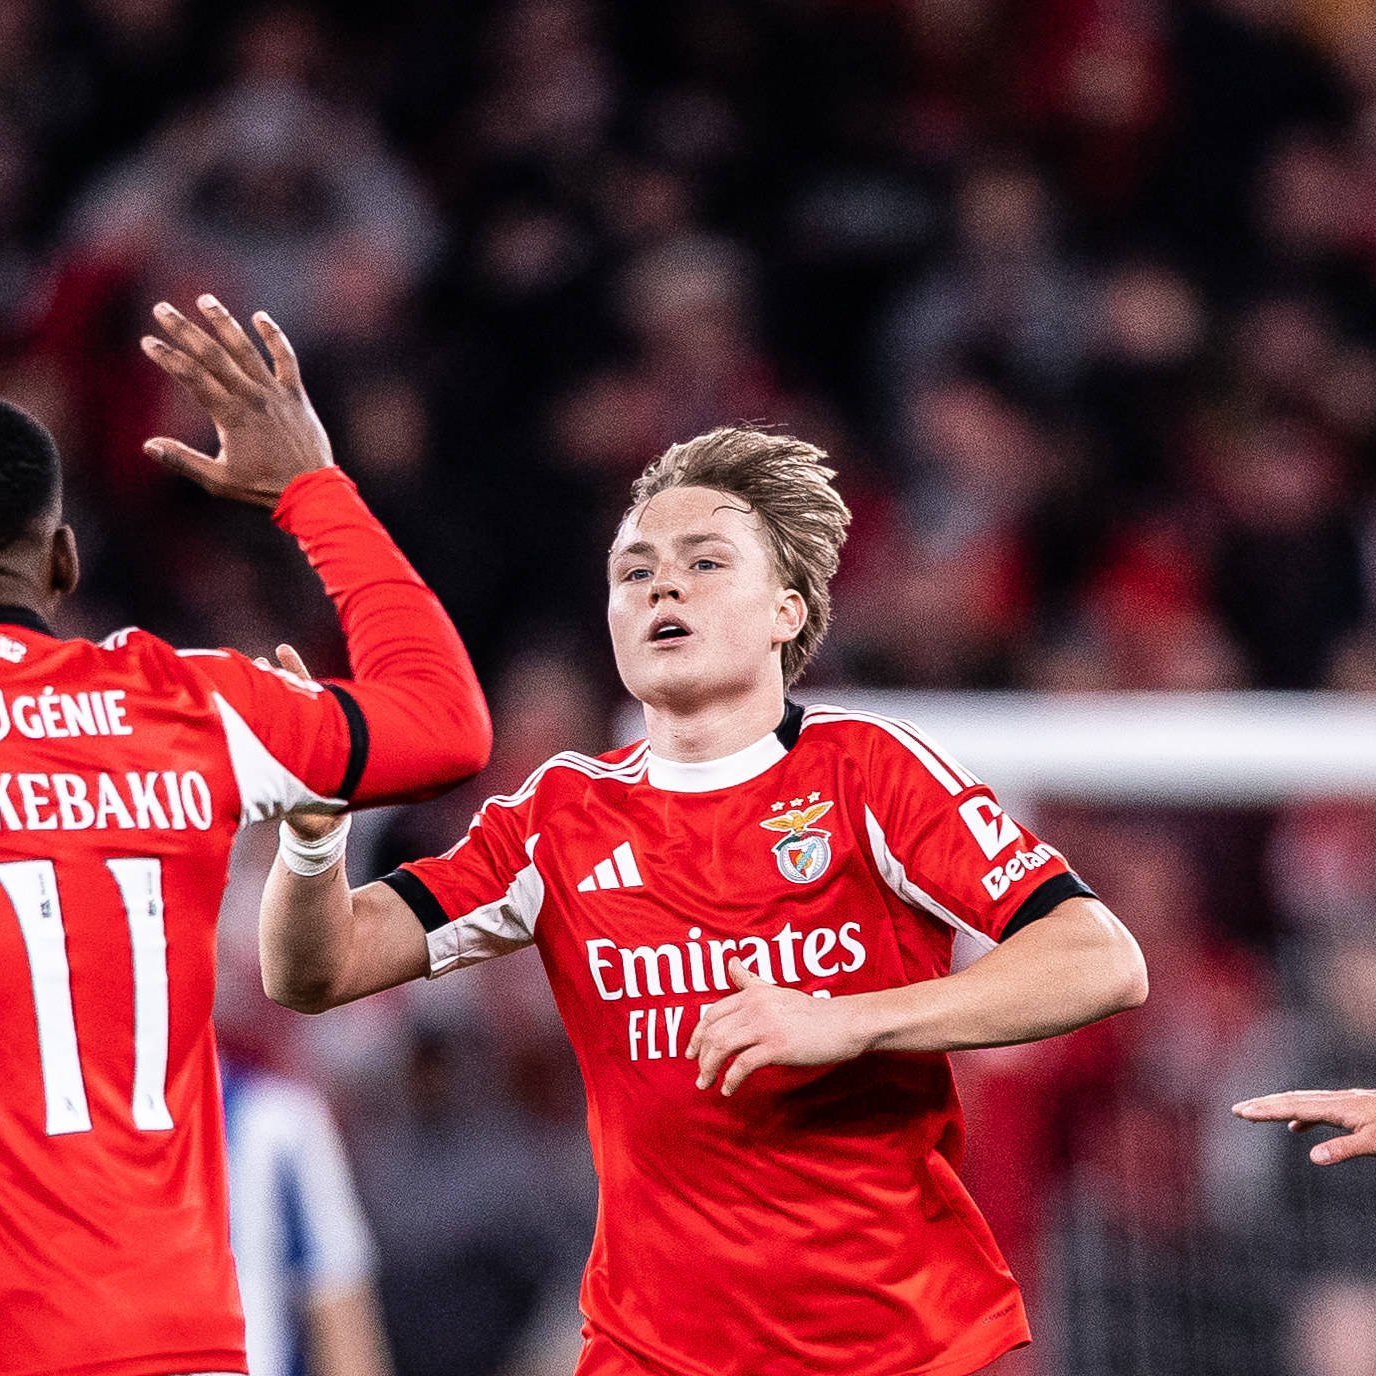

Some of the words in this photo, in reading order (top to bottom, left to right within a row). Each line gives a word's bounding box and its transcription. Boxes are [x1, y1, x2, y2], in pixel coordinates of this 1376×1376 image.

[12, 686, 133, 739] GÉNIE
[585, 921, 867, 1001] Emirates
[628, 1005, 684, 1061] FLY
